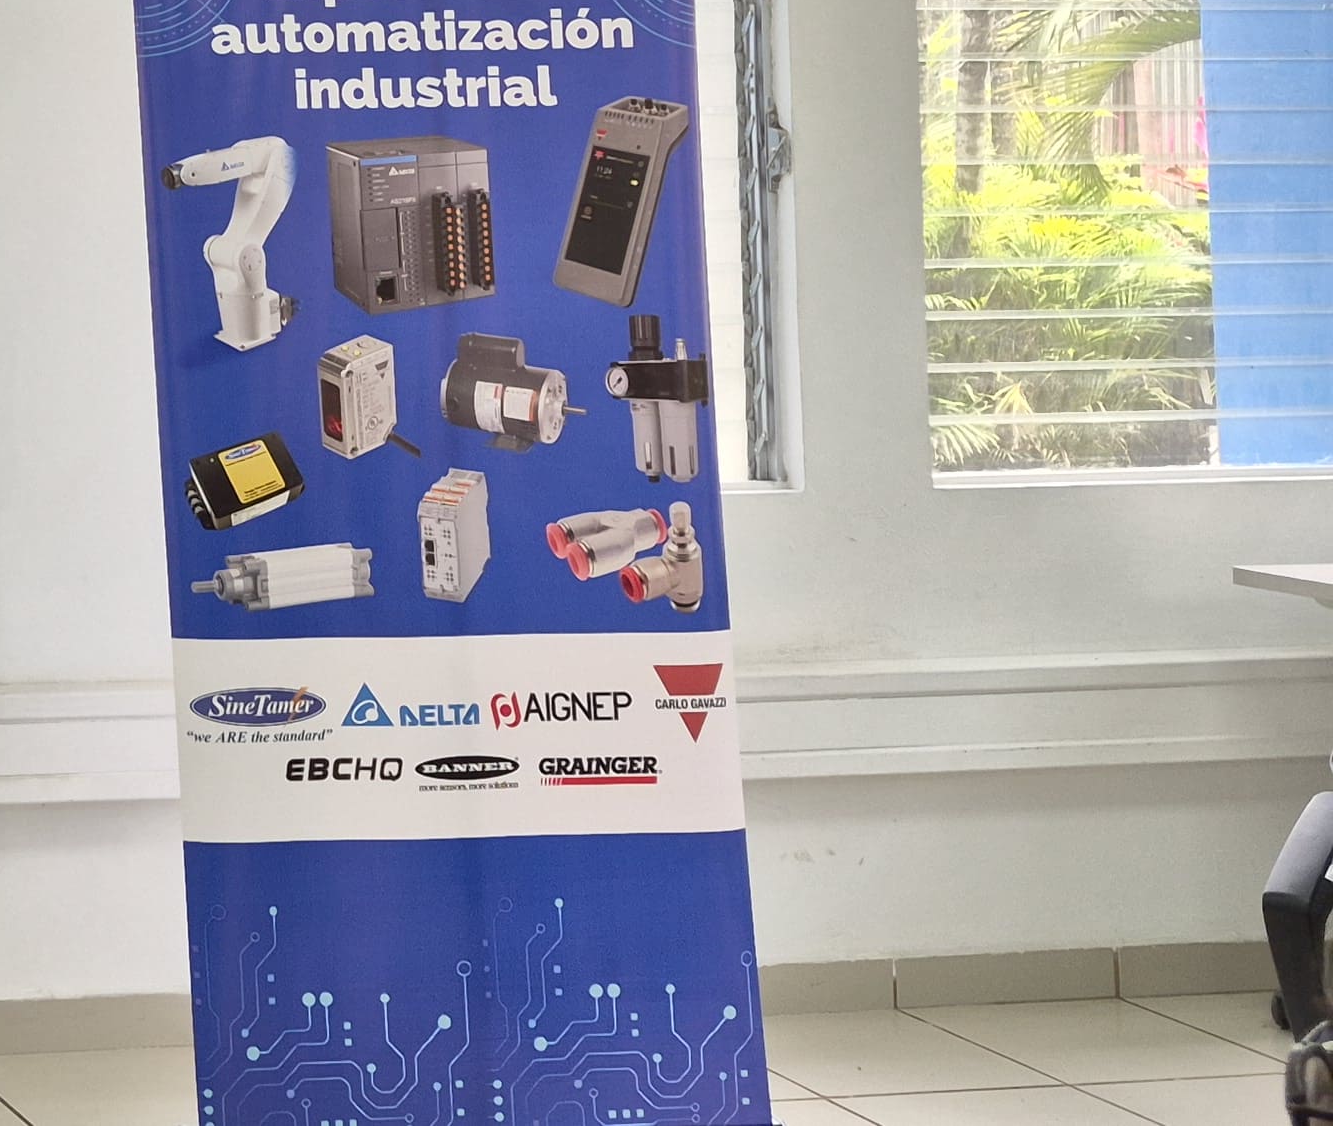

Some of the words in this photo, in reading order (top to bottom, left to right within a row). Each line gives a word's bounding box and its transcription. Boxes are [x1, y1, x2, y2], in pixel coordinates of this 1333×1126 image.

[210, 8, 634, 55] automatización
[294, 64, 559, 110] industrial
[207, 694, 314, 717] SineTamer
[523, 691, 633, 723] AIGNEP
[655, 698, 688, 710] CARLO
[690, 696, 727, 709] GAVAZZI
[399, 703, 481, 727] DELTA
[215, 730, 247, 743] ARE
[251, 730, 270, 743] the
[285, 757, 404, 781] EBCHQ
[421, 761, 515, 774] BANNER
[538, 756, 659, 776] GRAINGER
